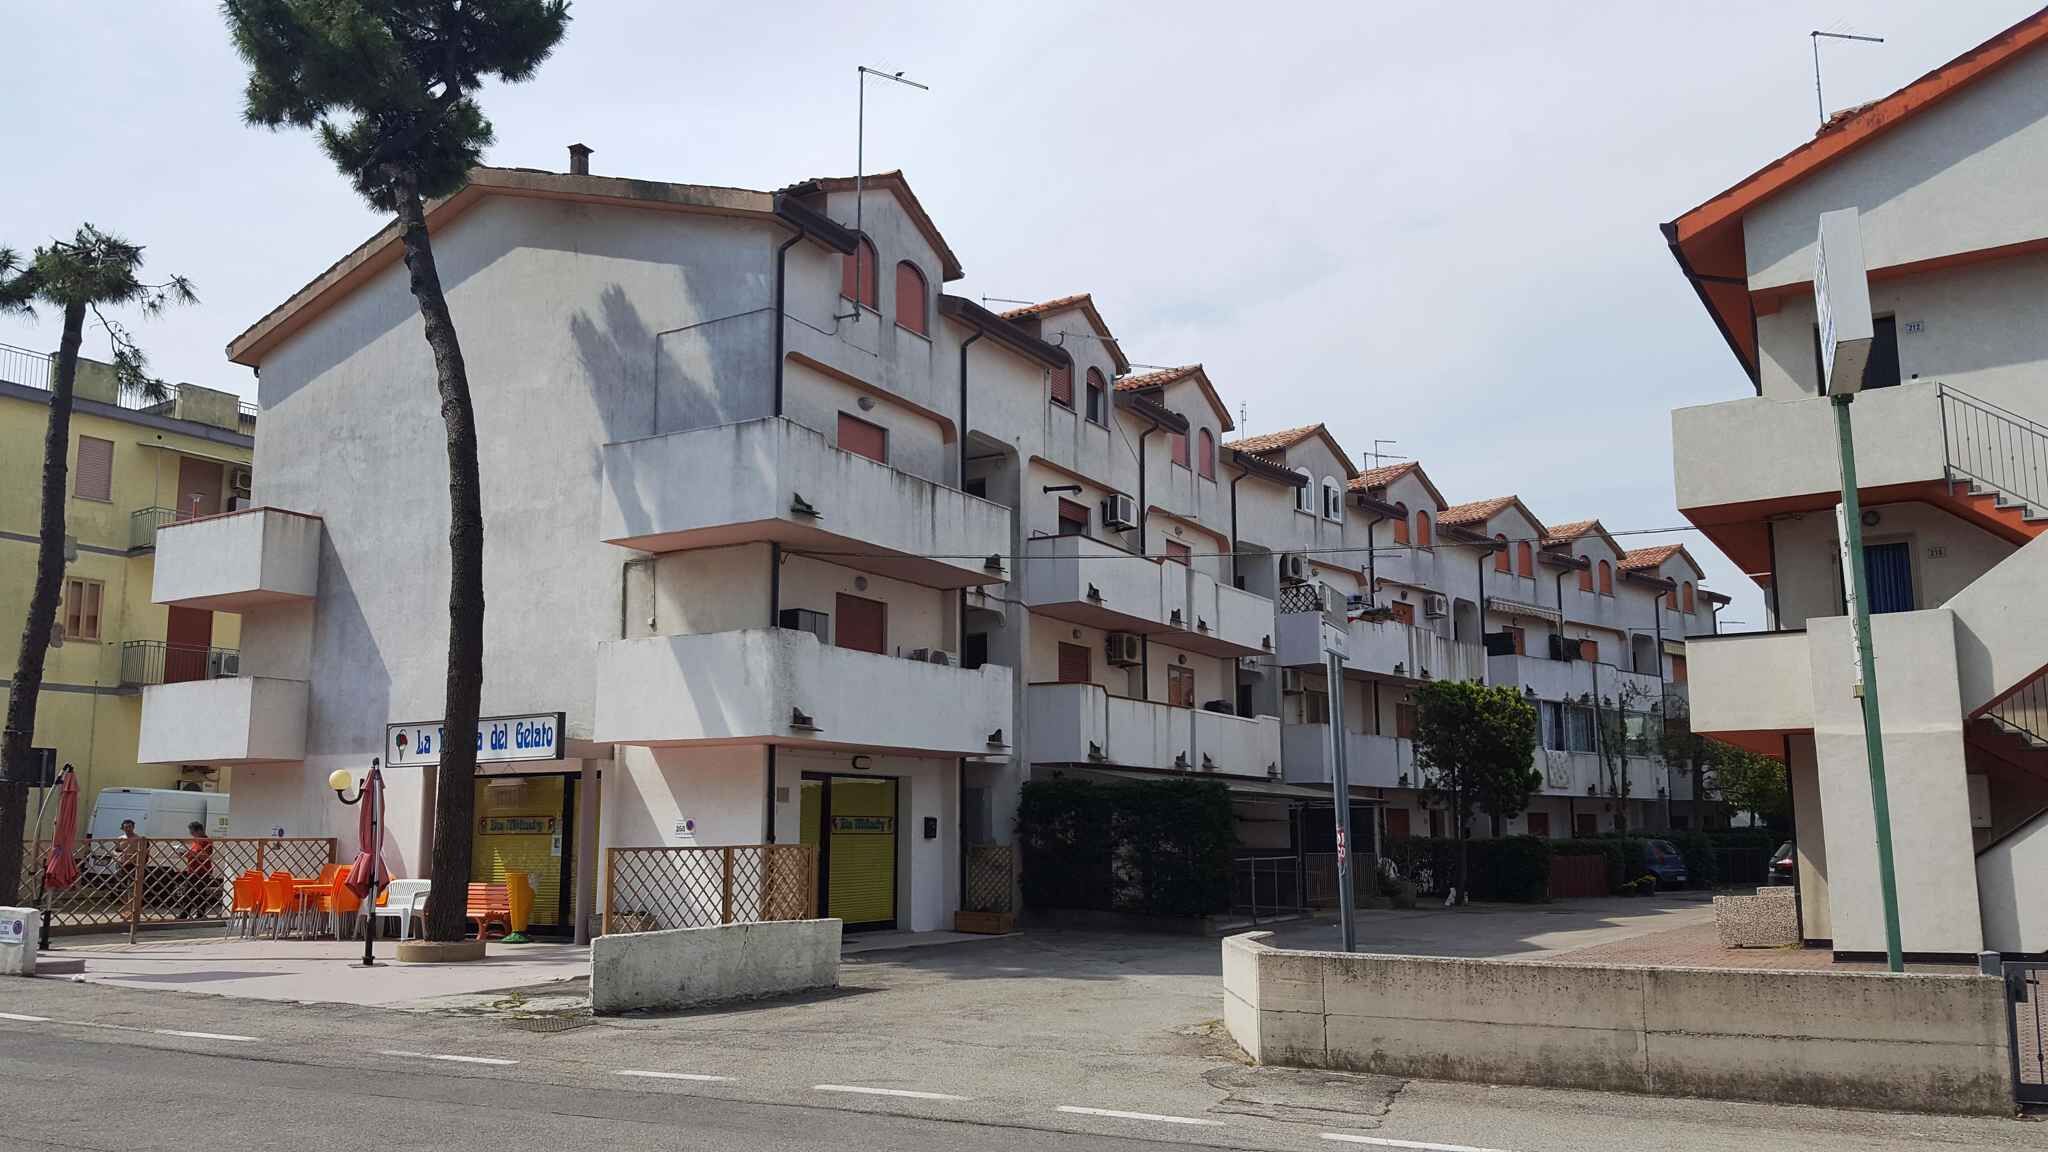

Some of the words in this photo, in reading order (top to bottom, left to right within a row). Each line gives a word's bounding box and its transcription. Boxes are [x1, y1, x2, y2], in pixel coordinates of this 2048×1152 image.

[416, 729, 431, 754] La
[490, 723, 508, 751] del
[515, 721, 553, 749] Gelato
